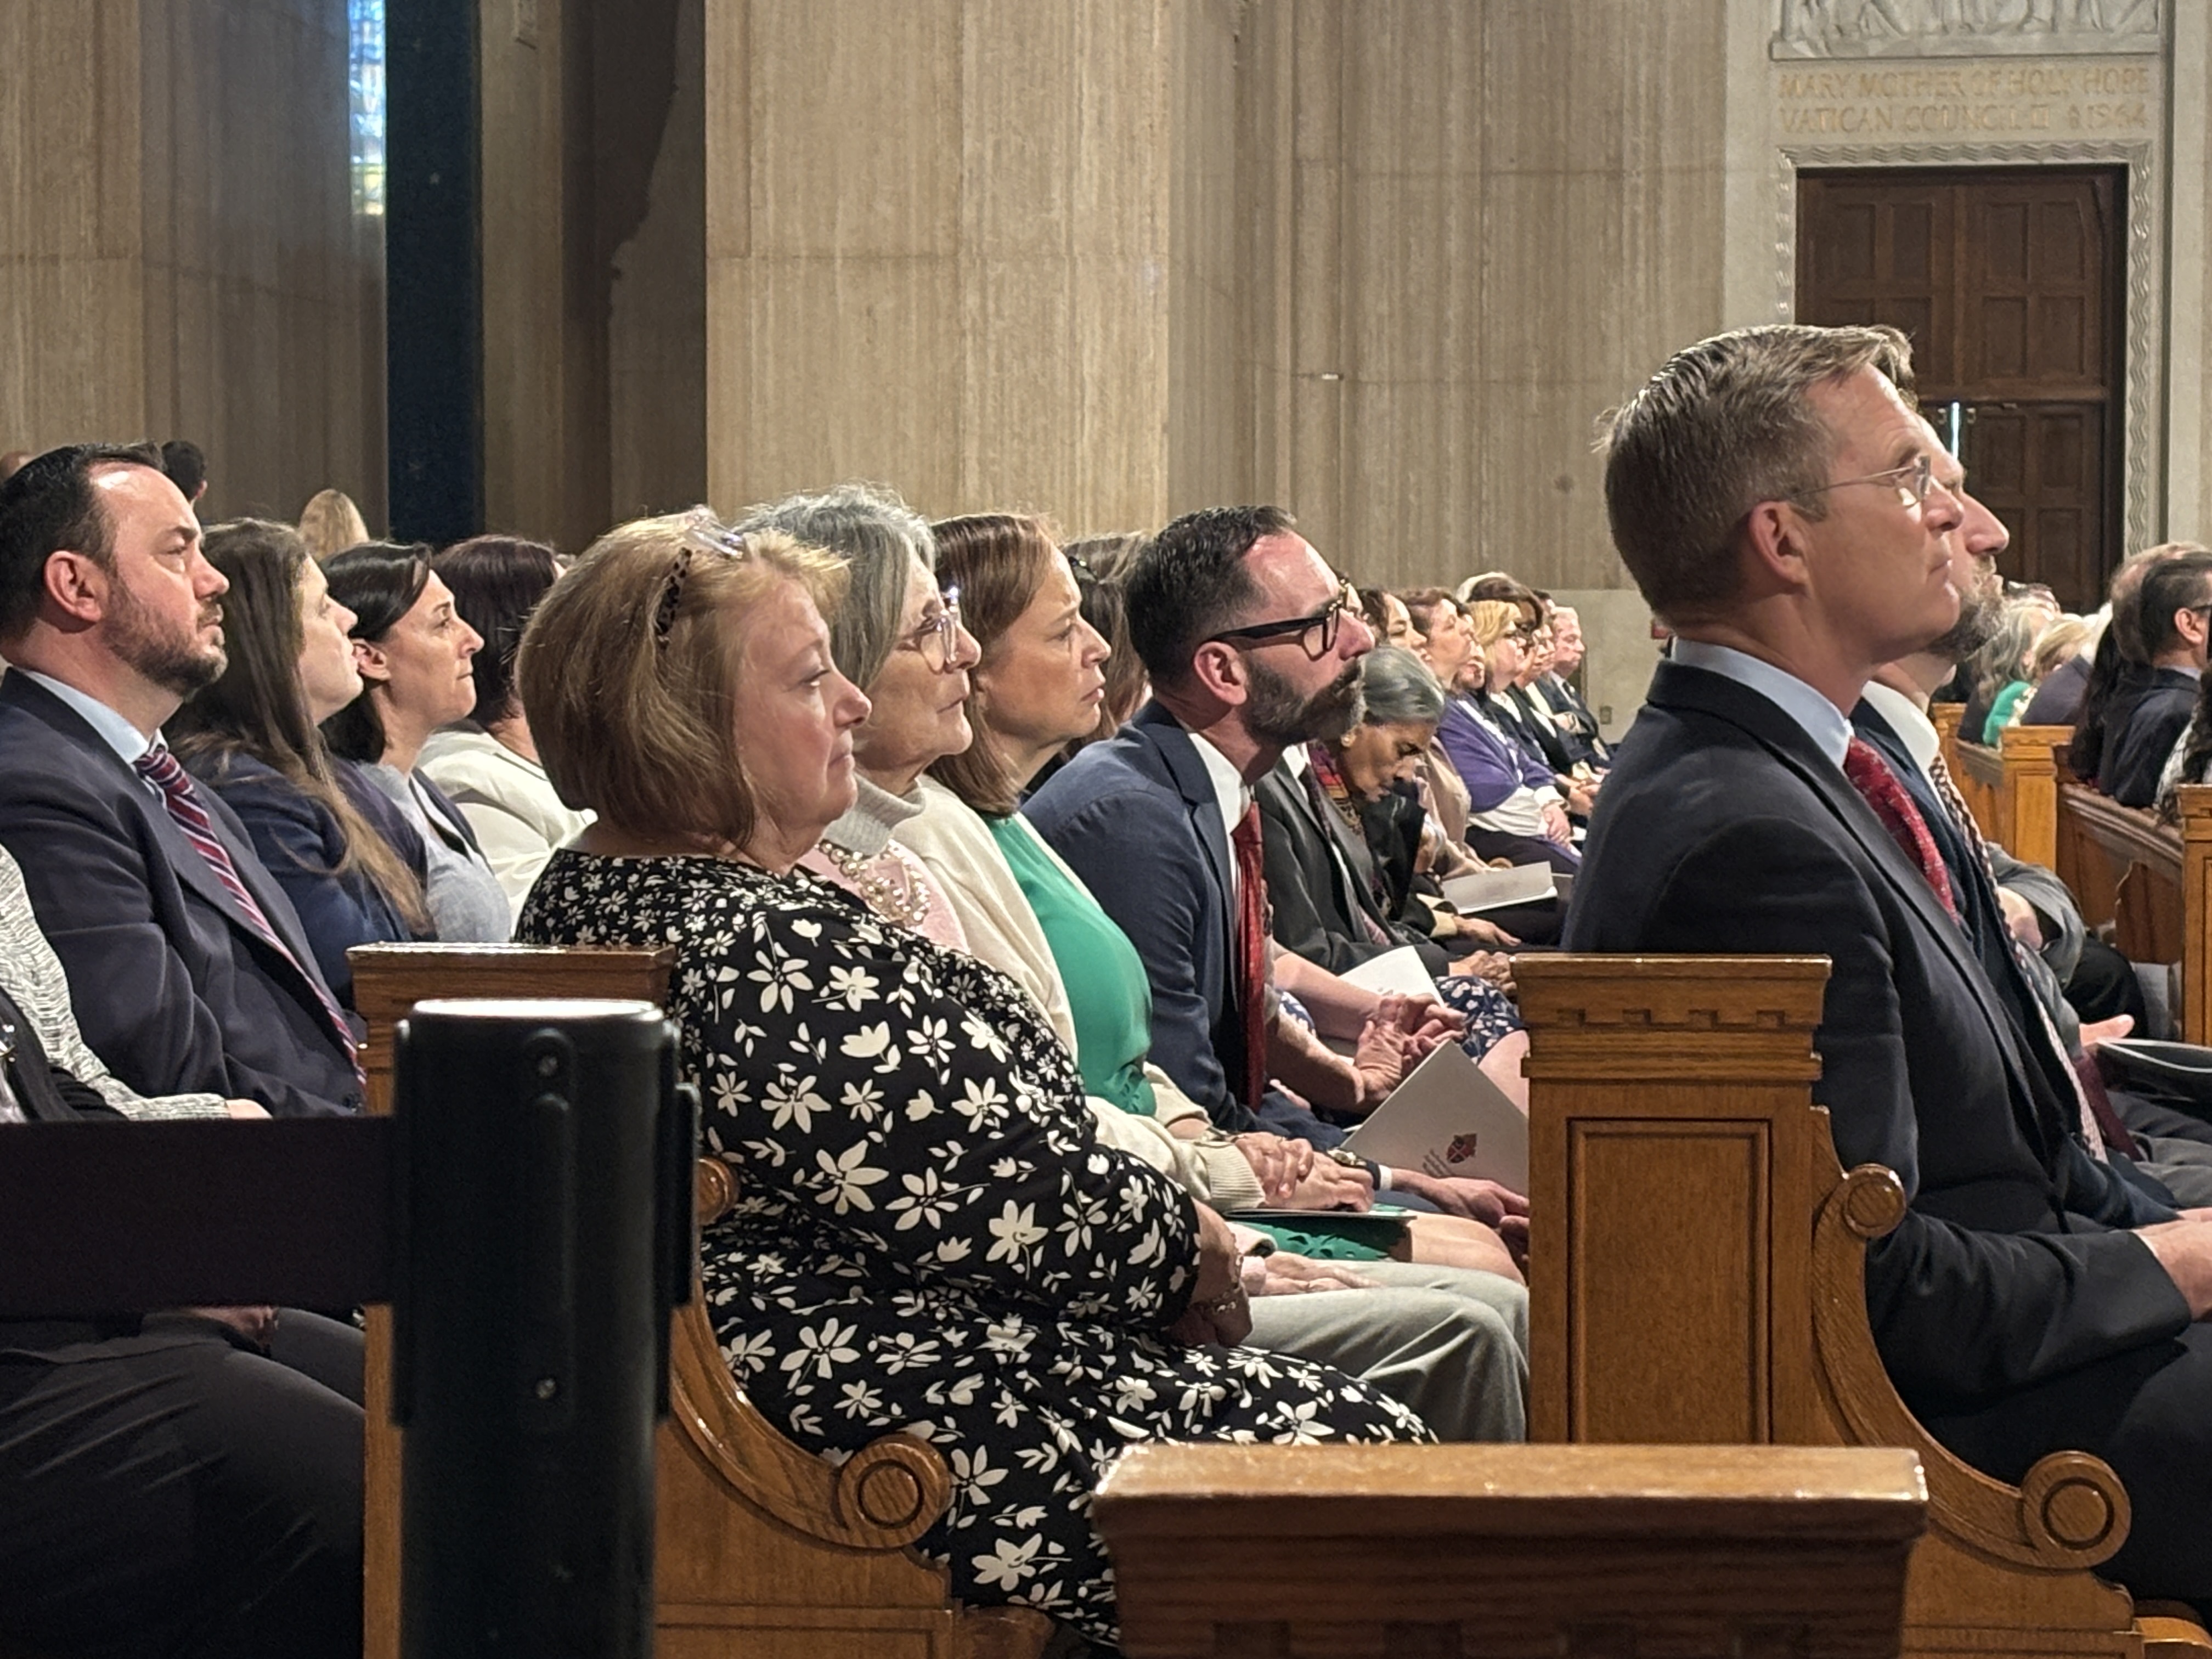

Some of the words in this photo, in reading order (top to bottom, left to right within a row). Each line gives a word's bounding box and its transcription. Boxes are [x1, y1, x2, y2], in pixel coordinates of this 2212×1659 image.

[1779, 73, 1852, 99] MARY
[1858, 71, 1966, 98] MOTHER
[1971, 70, 2001, 97] OF
[2008, 69, 2070, 96] HOLY
[2084, 67, 2149, 94] HOPE
[1779, 105, 1893, 133] VATICAN
[1904, 104, 2022, 132] COUNCIL
